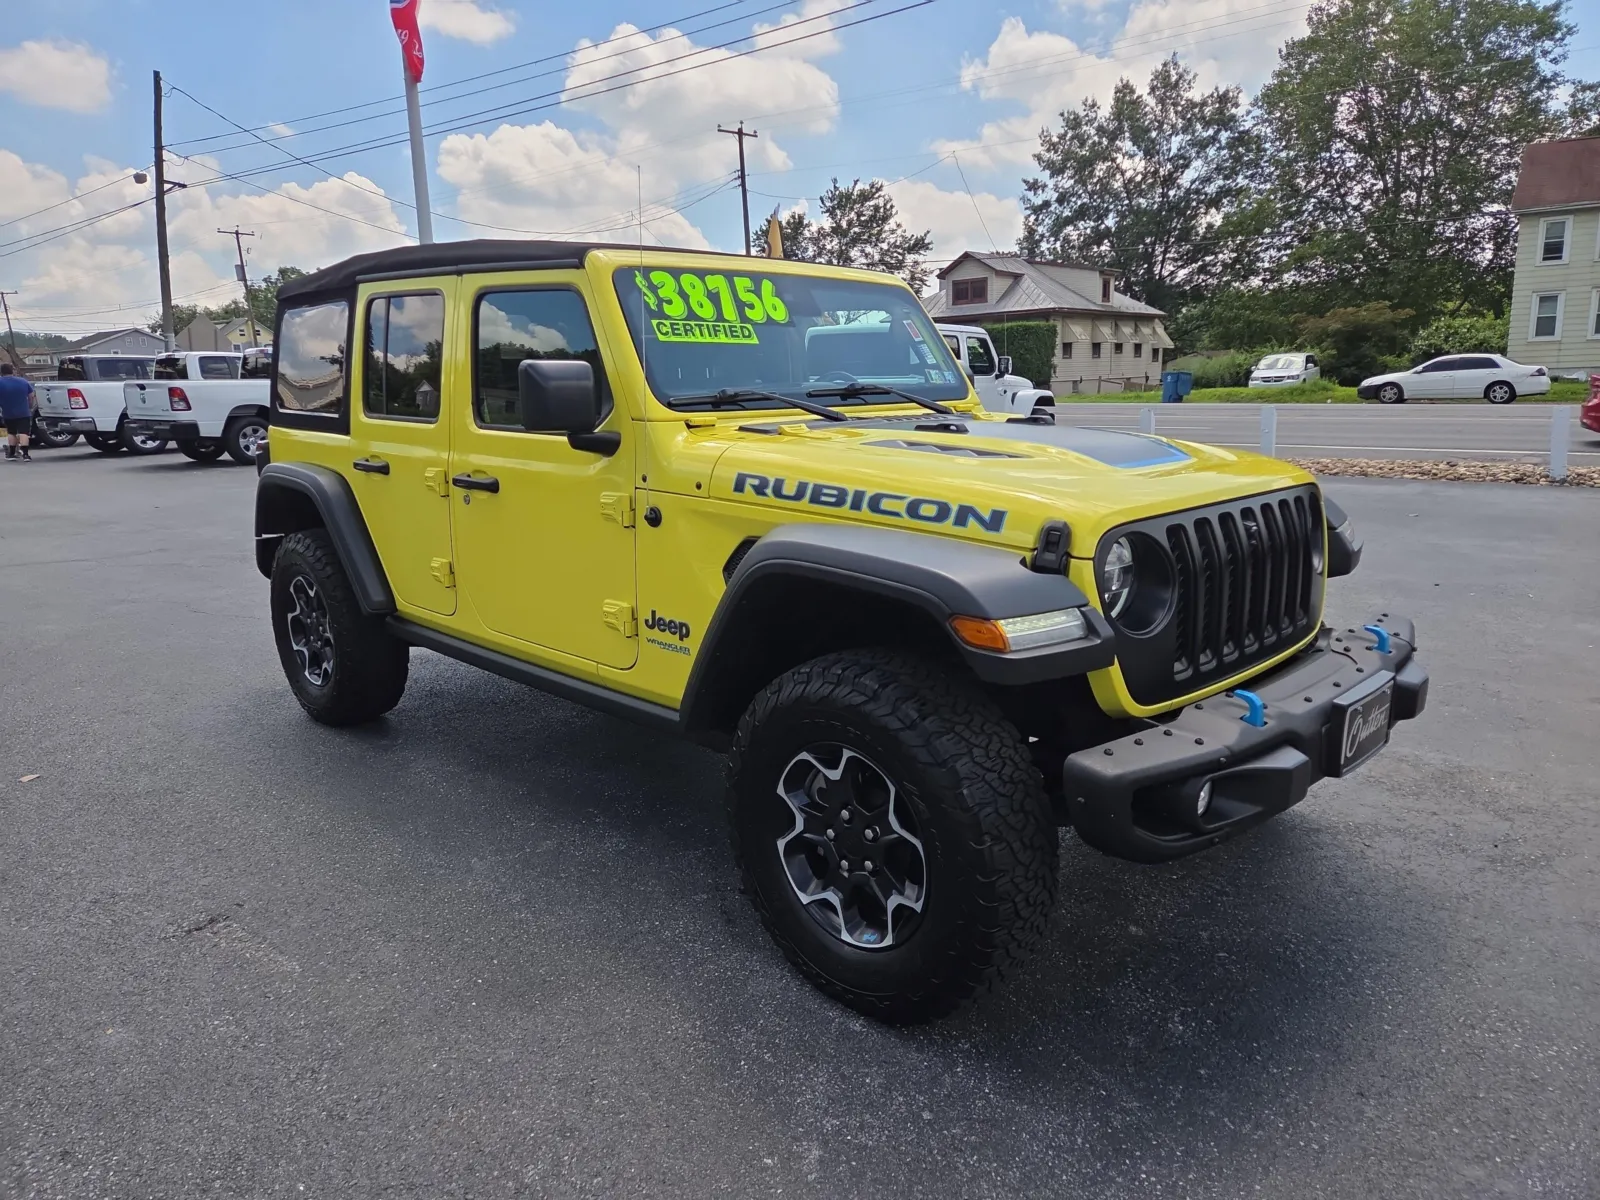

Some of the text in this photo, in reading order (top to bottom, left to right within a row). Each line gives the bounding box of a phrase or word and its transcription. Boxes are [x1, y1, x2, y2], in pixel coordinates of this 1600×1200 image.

[635, 270, 790, 324] $38756
[655, 321, 754, 341] CERTIFIED
[732, 472, 1008, 534] RUBICON
[644, 609, 690, 642] Jeep
[645, 636, 691, 653] WRANGLER
